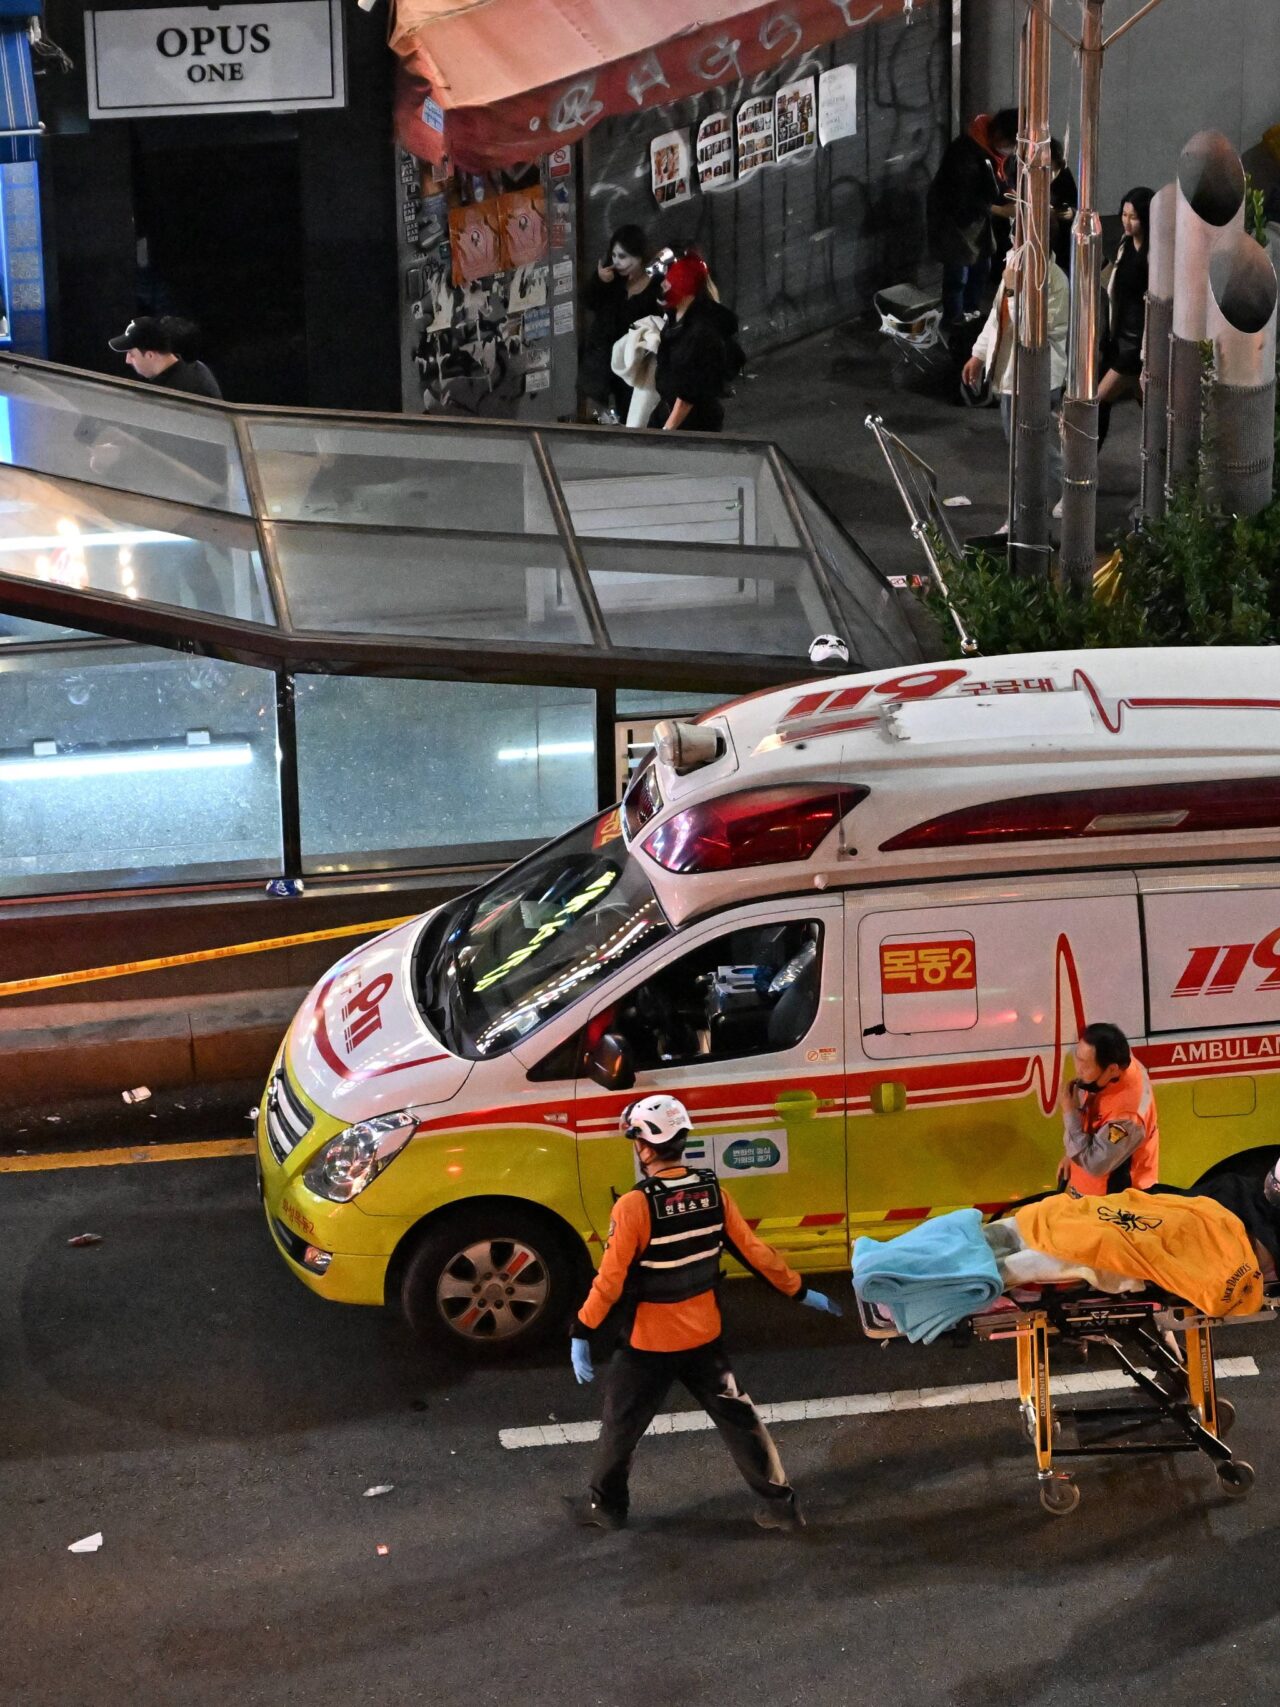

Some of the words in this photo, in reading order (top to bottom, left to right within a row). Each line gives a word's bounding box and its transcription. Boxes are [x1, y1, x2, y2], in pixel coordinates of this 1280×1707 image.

[156, 23, 271, 57] OPUS
[187, 62, 244, 83] ONE
[780, 668, 968, 722] 119
[961, 678, 1055, 696] 구급대
[882, 947, 973, 985] 목동2
